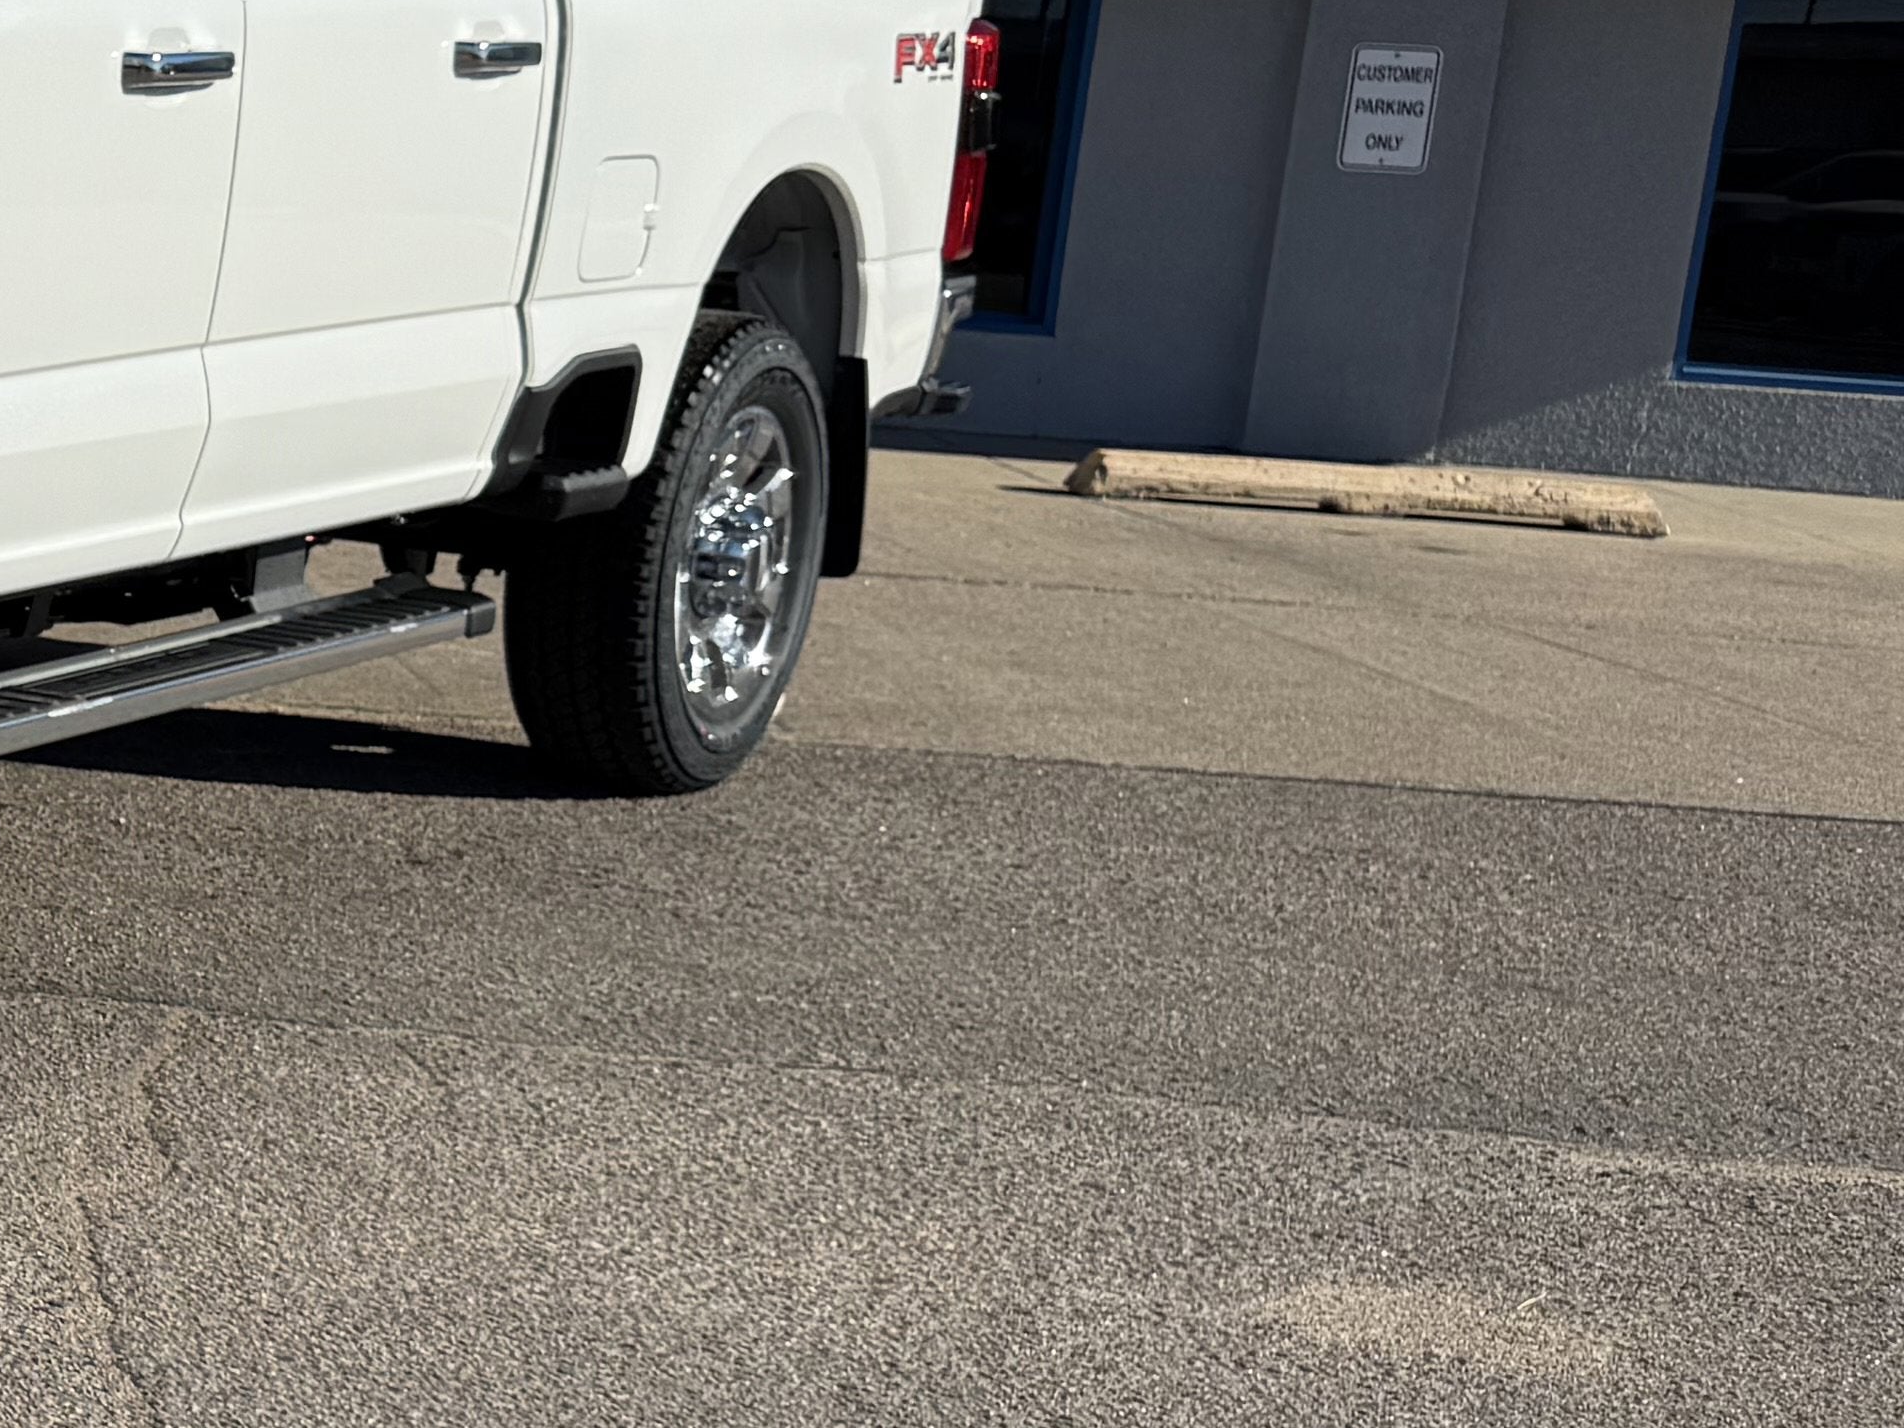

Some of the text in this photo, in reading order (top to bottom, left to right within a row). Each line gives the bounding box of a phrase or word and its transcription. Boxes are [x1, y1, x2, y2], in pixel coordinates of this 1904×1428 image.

[894, 31, 955, 83] FX4
[1356, 63, 1433, 83] CUSTOMER
[1354, 97, 1425, 118] PARKING
[1365, 132, 1404, 151] ONLY
